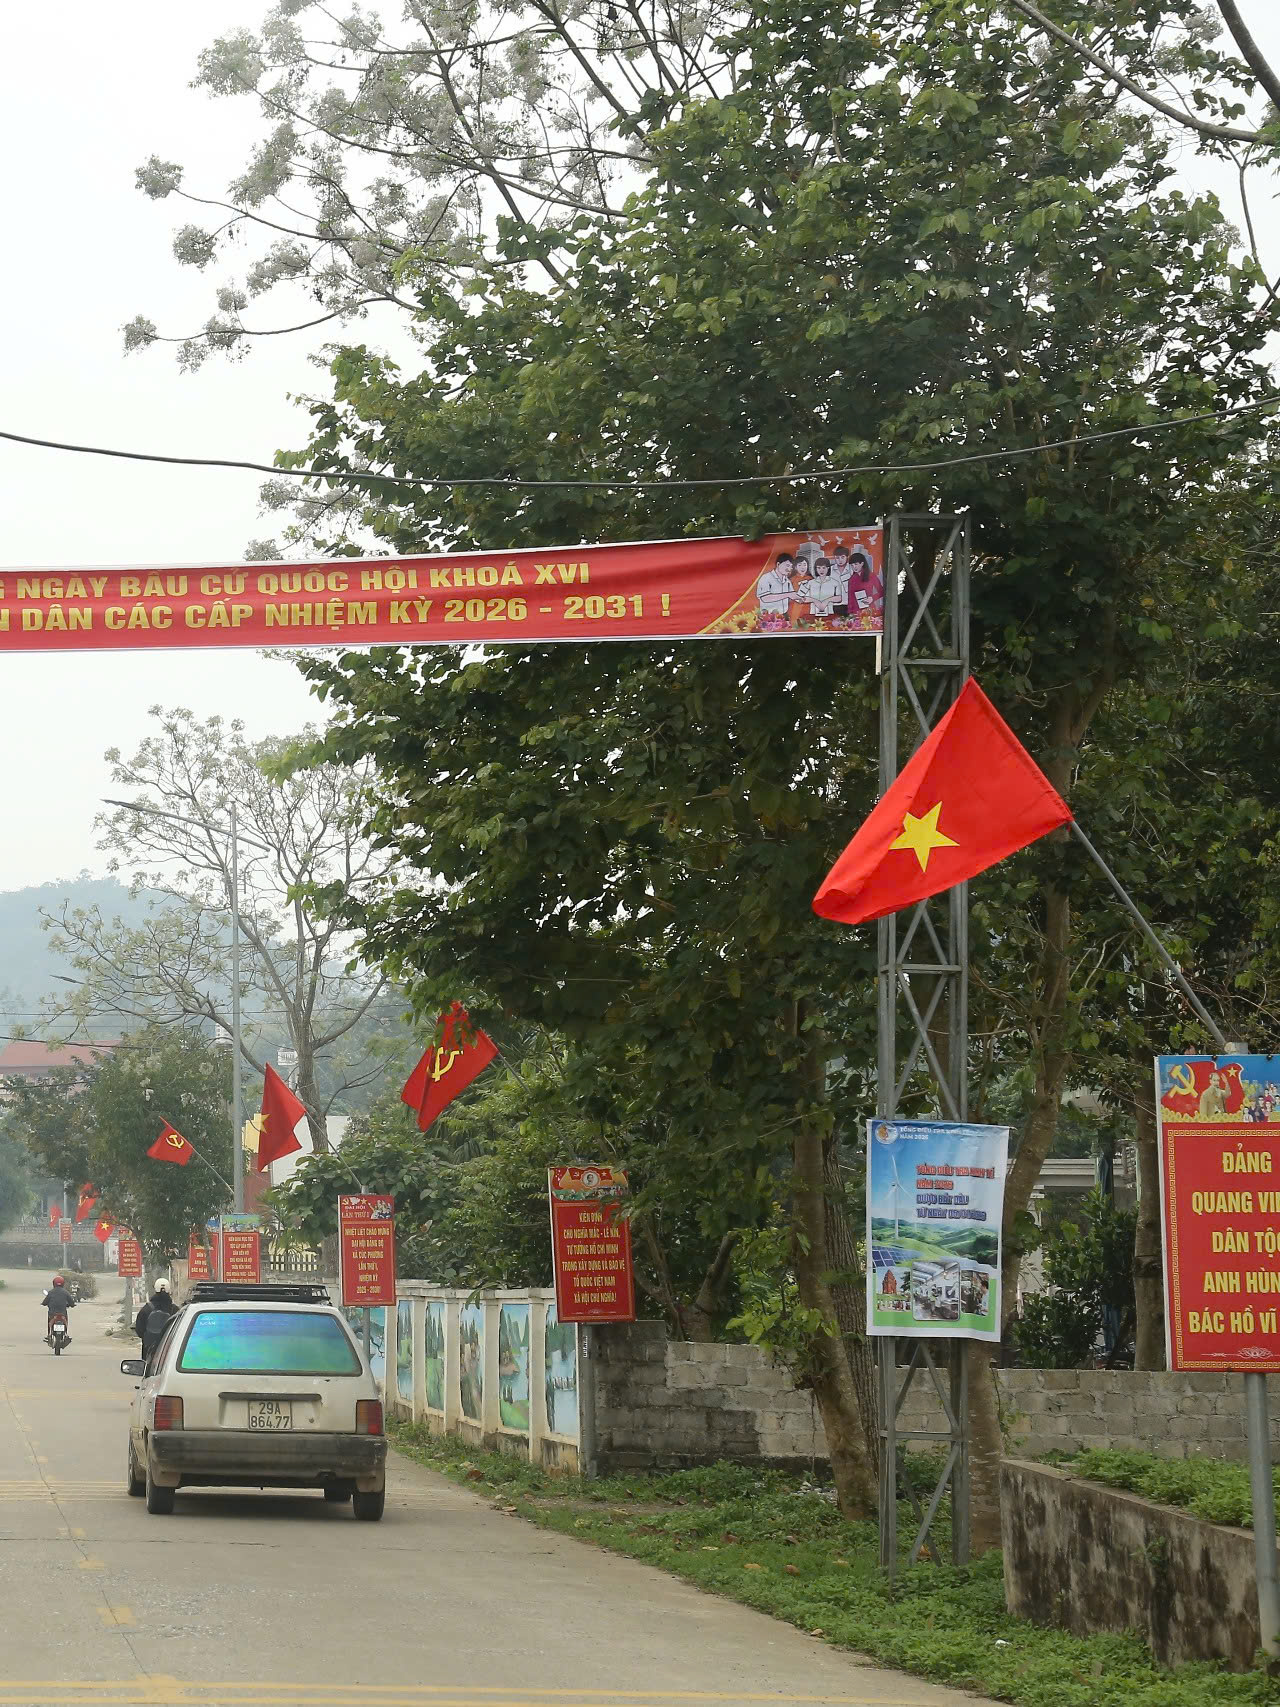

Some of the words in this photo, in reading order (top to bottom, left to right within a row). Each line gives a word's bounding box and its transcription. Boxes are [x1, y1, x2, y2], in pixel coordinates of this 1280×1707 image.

[16, 573, 108, 599] NGÀY
[120, 571, 188, 598] BẦU
[200, 568, 249, 596] CỬ
[257, 564, 349, 596] QUỐC
[360, 566, 418, 594] HỘI
[429, 561, 524, 588] KHOÁ
[533, 563, 590, 585] XVI
[21, 603, 93, 631] DÂN
[104, 602, 173, 630] CÁC
[184, 598, 254, 629] CẤP
[265, 598, 378, 631] NHIỆM
[389, 596, 433, 624] KỲ
[444, 598, 528, 623] 2026
[563, 594, 643, 619] 2031
[1222, 1143, 1272, 1173] ĐẢNG
[1192, 1191, 1253, 1215] QUANG
[1212, 1227, 1249, 1253] DÂN
[1203, 1271, 1241, 1293] ANH
[1188, 1307, 1225, 1333] BÁC
[1230, 1305, 1255, 1333] HỒ
[1258, 1307, 1278, 1334] VĨ
[259, 1402, 281, 1415] 29A
[251, 1416, 289, 1428] 864.77
